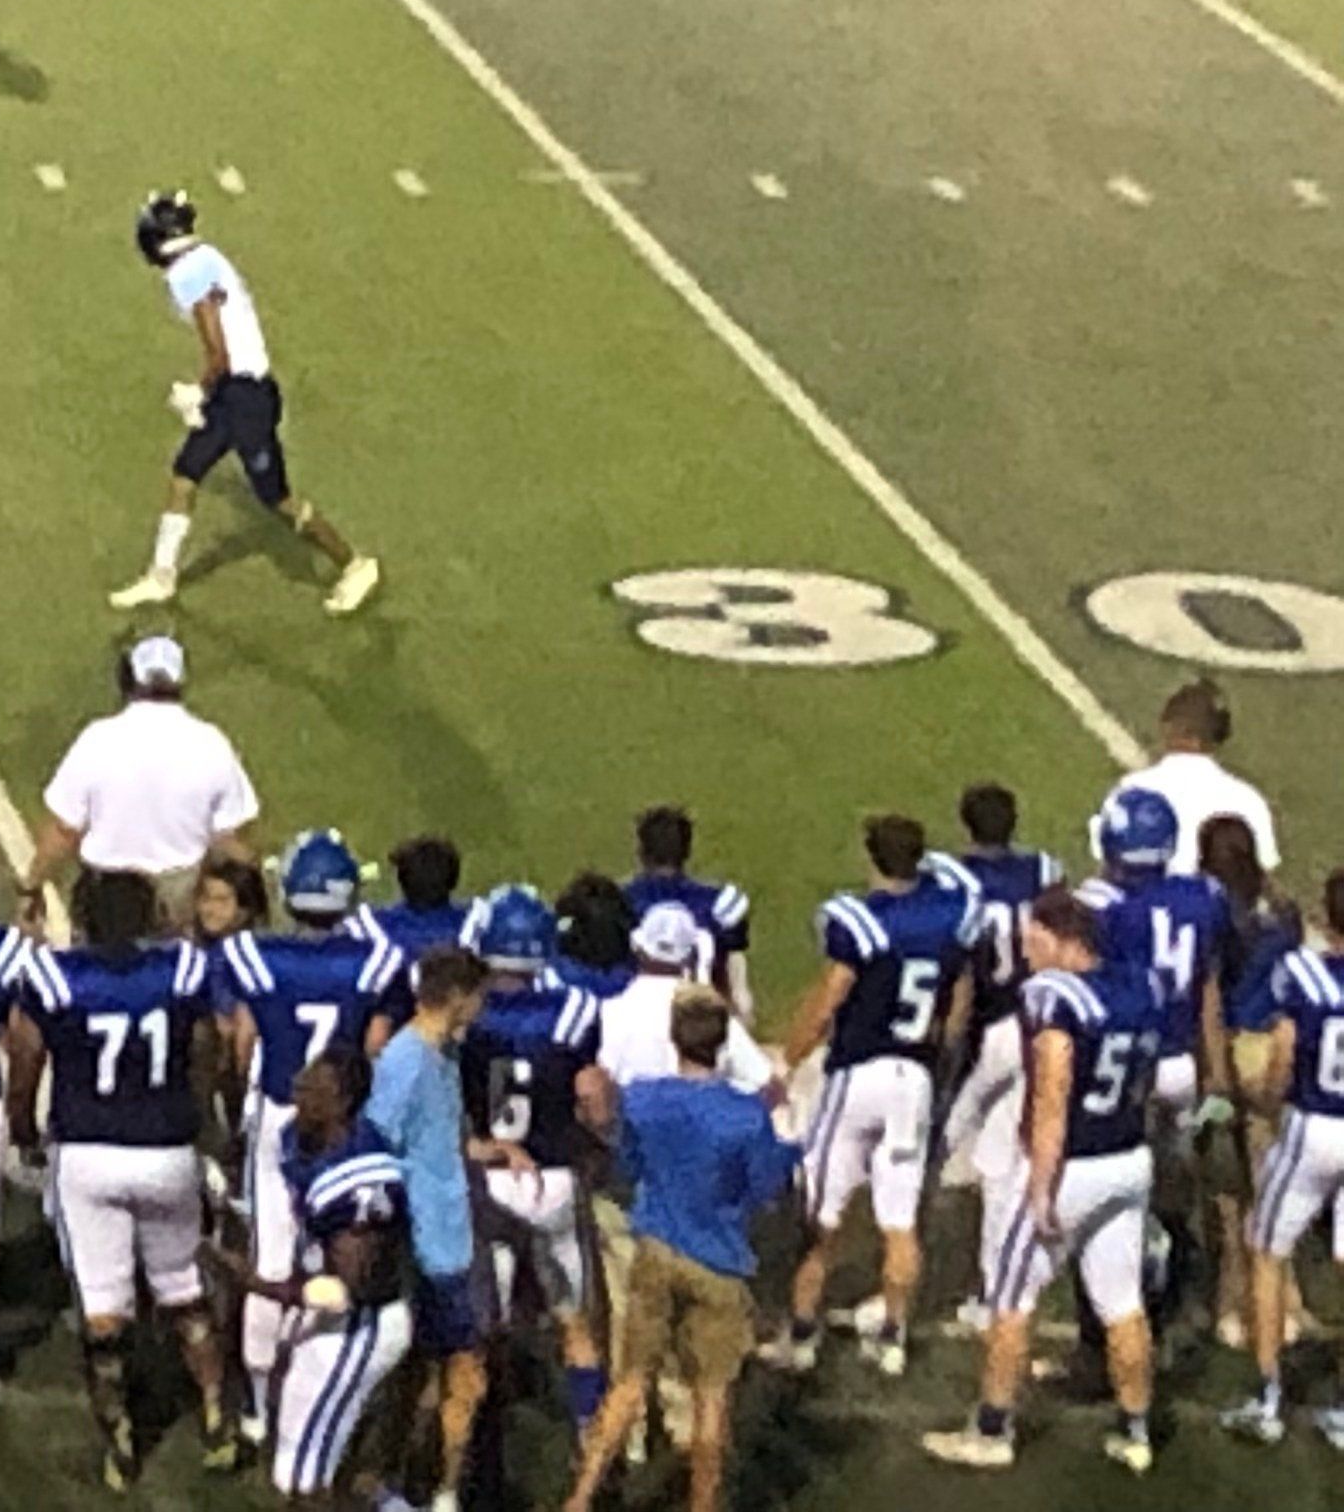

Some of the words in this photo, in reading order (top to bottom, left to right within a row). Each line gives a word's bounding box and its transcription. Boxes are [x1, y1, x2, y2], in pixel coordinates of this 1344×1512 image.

[295, 1004, 340, 1064] 7
[891, 958, 940, 1042] 5
[87, 1008, 168, 1094] 71
